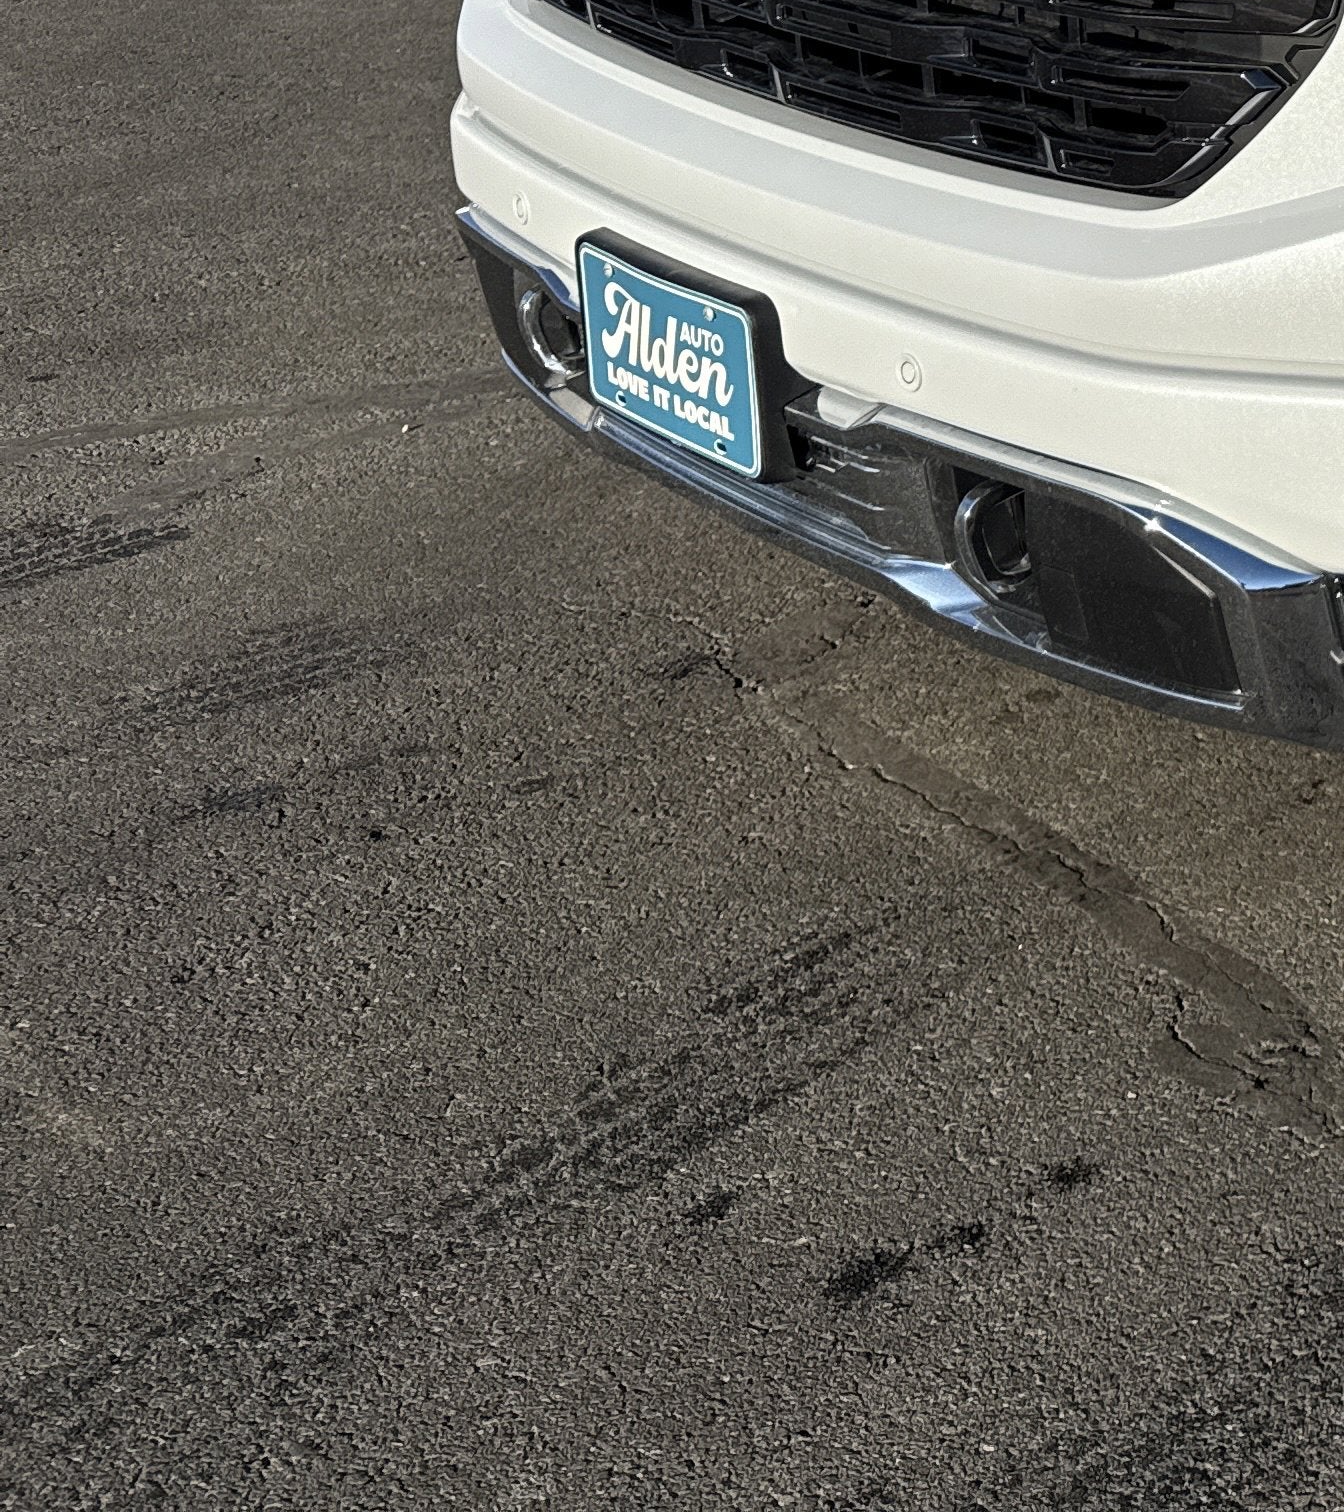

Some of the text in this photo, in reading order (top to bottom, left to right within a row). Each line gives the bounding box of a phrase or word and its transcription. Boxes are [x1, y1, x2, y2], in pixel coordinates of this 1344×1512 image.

[602, 282, 733, 406] Alden
[680, 322, 724, 356] AUTO
[607, 361, 735, 441] LOVE IT LOCAL
